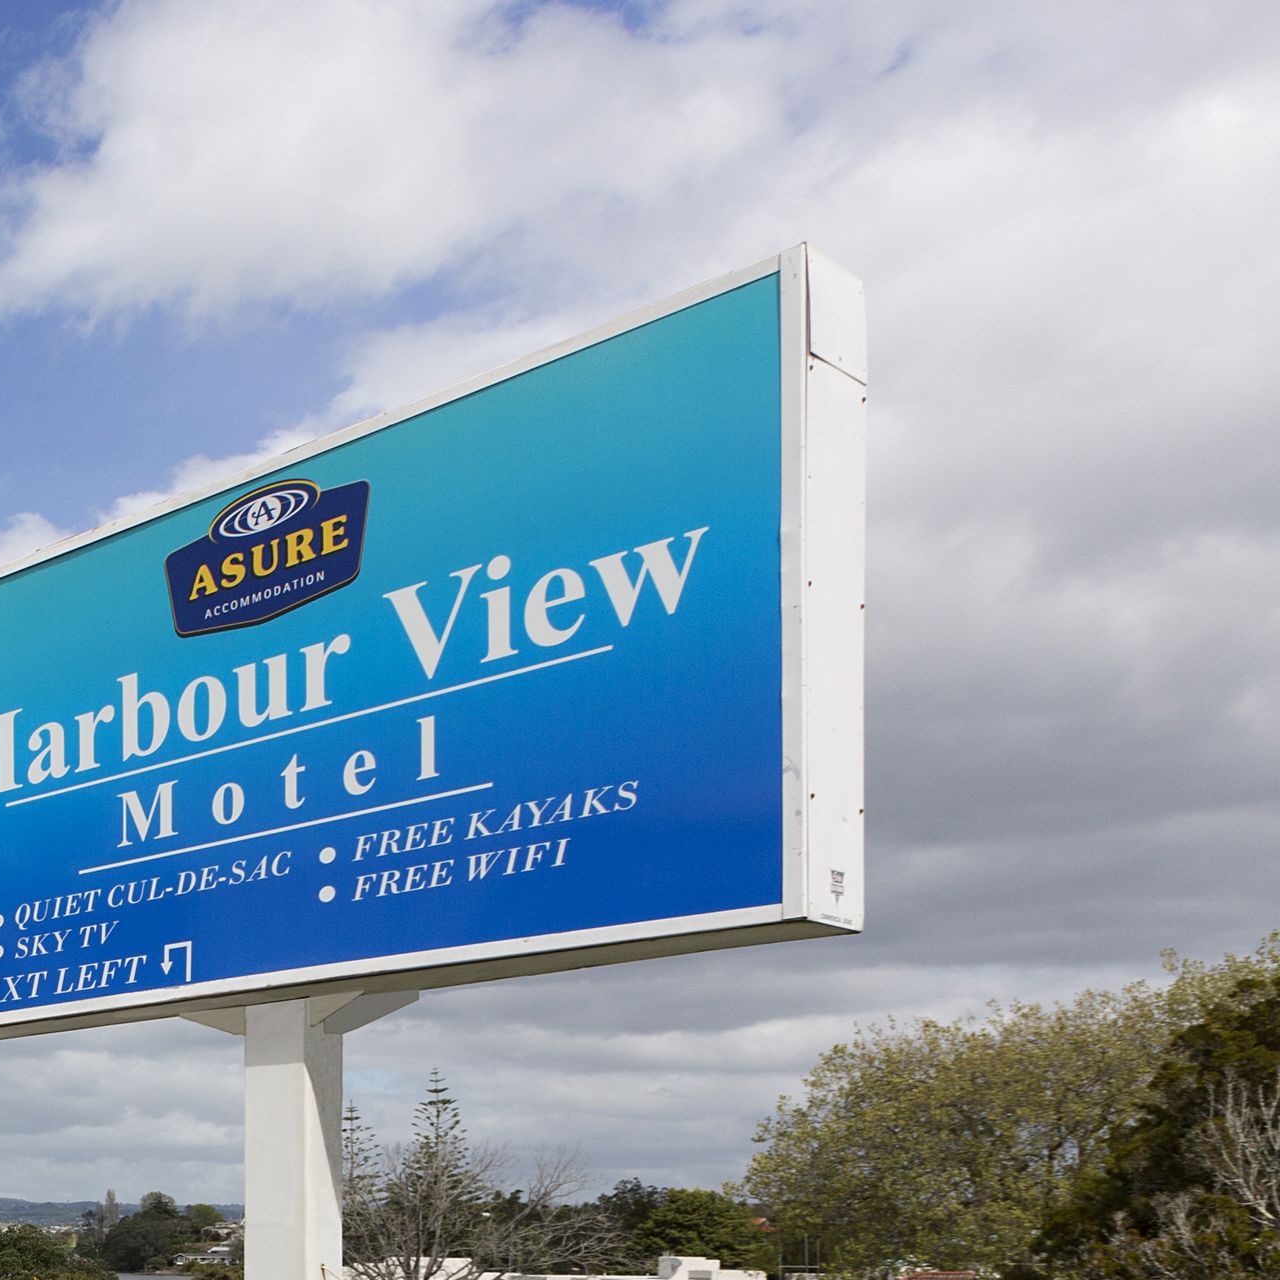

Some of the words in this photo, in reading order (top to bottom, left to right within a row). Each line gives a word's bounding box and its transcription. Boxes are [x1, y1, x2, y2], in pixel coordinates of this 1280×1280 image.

[189, 514, 349, 601] ASURE
[204, 570, 326, 620] ACCOMMODATION
[382, 526, 710, 681] View
[116, 714, 440, 848] Motel
[351, 817, 455, 862] FREE
[464, 780, 639, 841] KAYAKS
[14, 888, 102, 932] QUIET
[107, 851, 292, 909] CUL-DE-SAC
[351, 859, 454, 902] FREE
[467, 837, 571, 882] WIFI
[14, 928, 73, 960] SKY
[79, 920, 120, 949] TV
[53, 954, 147, 996] LEFT
